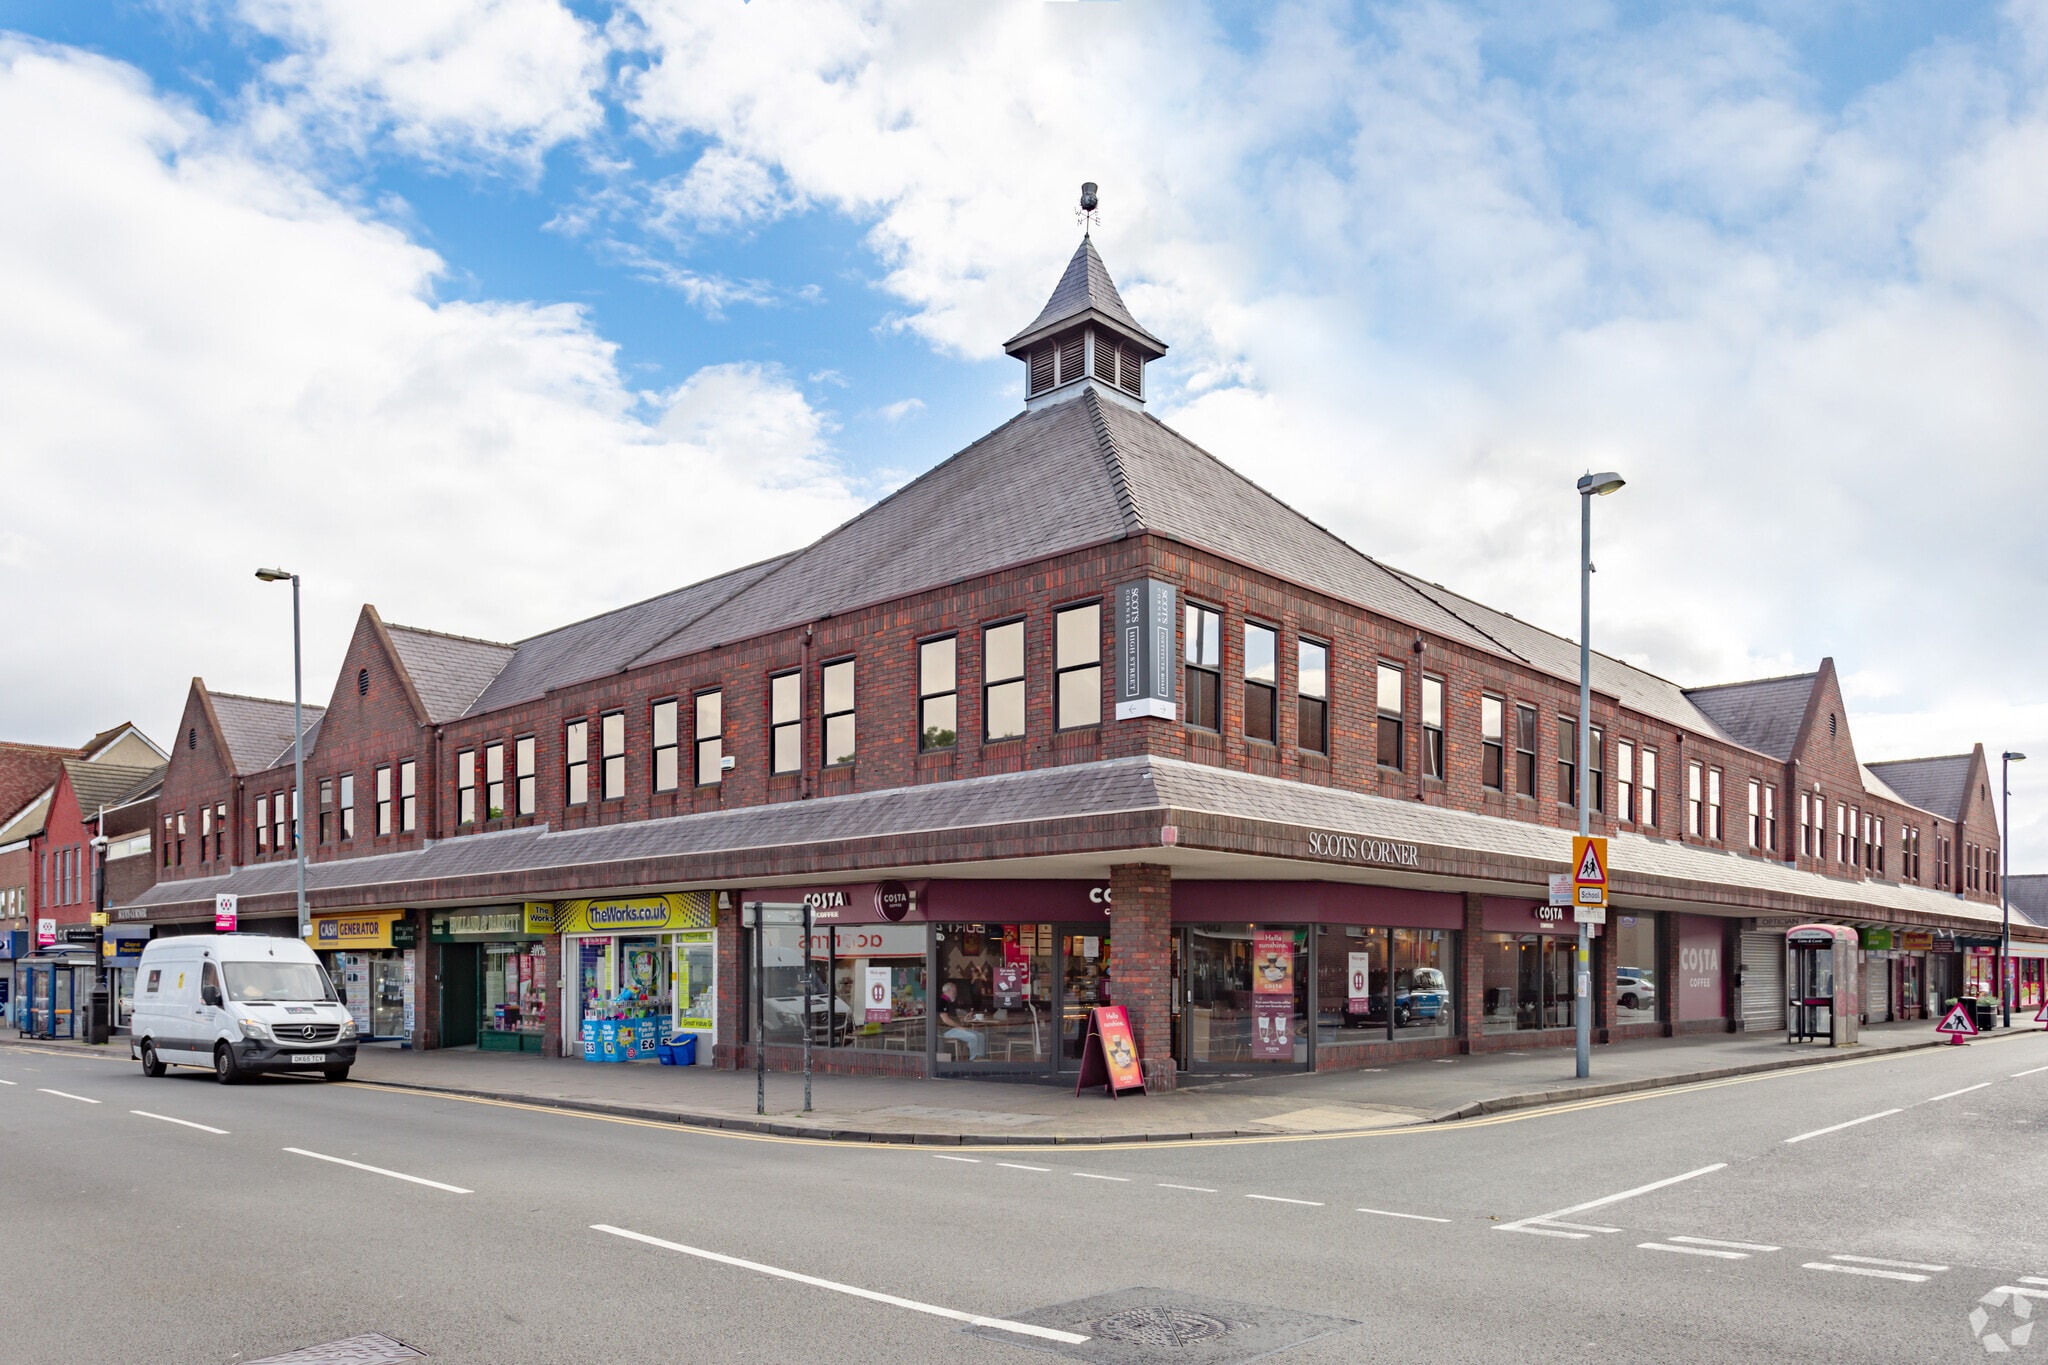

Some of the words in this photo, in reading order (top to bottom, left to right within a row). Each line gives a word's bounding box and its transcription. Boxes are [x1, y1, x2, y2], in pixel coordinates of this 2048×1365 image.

[1309, 832, 1356, 859] SCOTS
[1361, 839, 1418, 866] CORNER
[804, 892, 844, 908] COSTA
[884, 894, 906, 903] COSTA
[1581, 890, 1600, 900] School
[590, 903, 666, 923] TheWorks.co.uk
[1539, 906, 1563, 920] COSTA
[320, 923, 337, 936] CASH
[340, 922, 379, 935] GENERATOR
[450, 916, 480, 932] HOLLAND
[1681, 948, 1718, 974] COSTA
[1690, 978, 1710, 987] COFFEE
[1106, 1012, 1118, 1020] Hello
[586, 1043, 594, 1052] £3
[642, 1040, 654, 1049] £6
